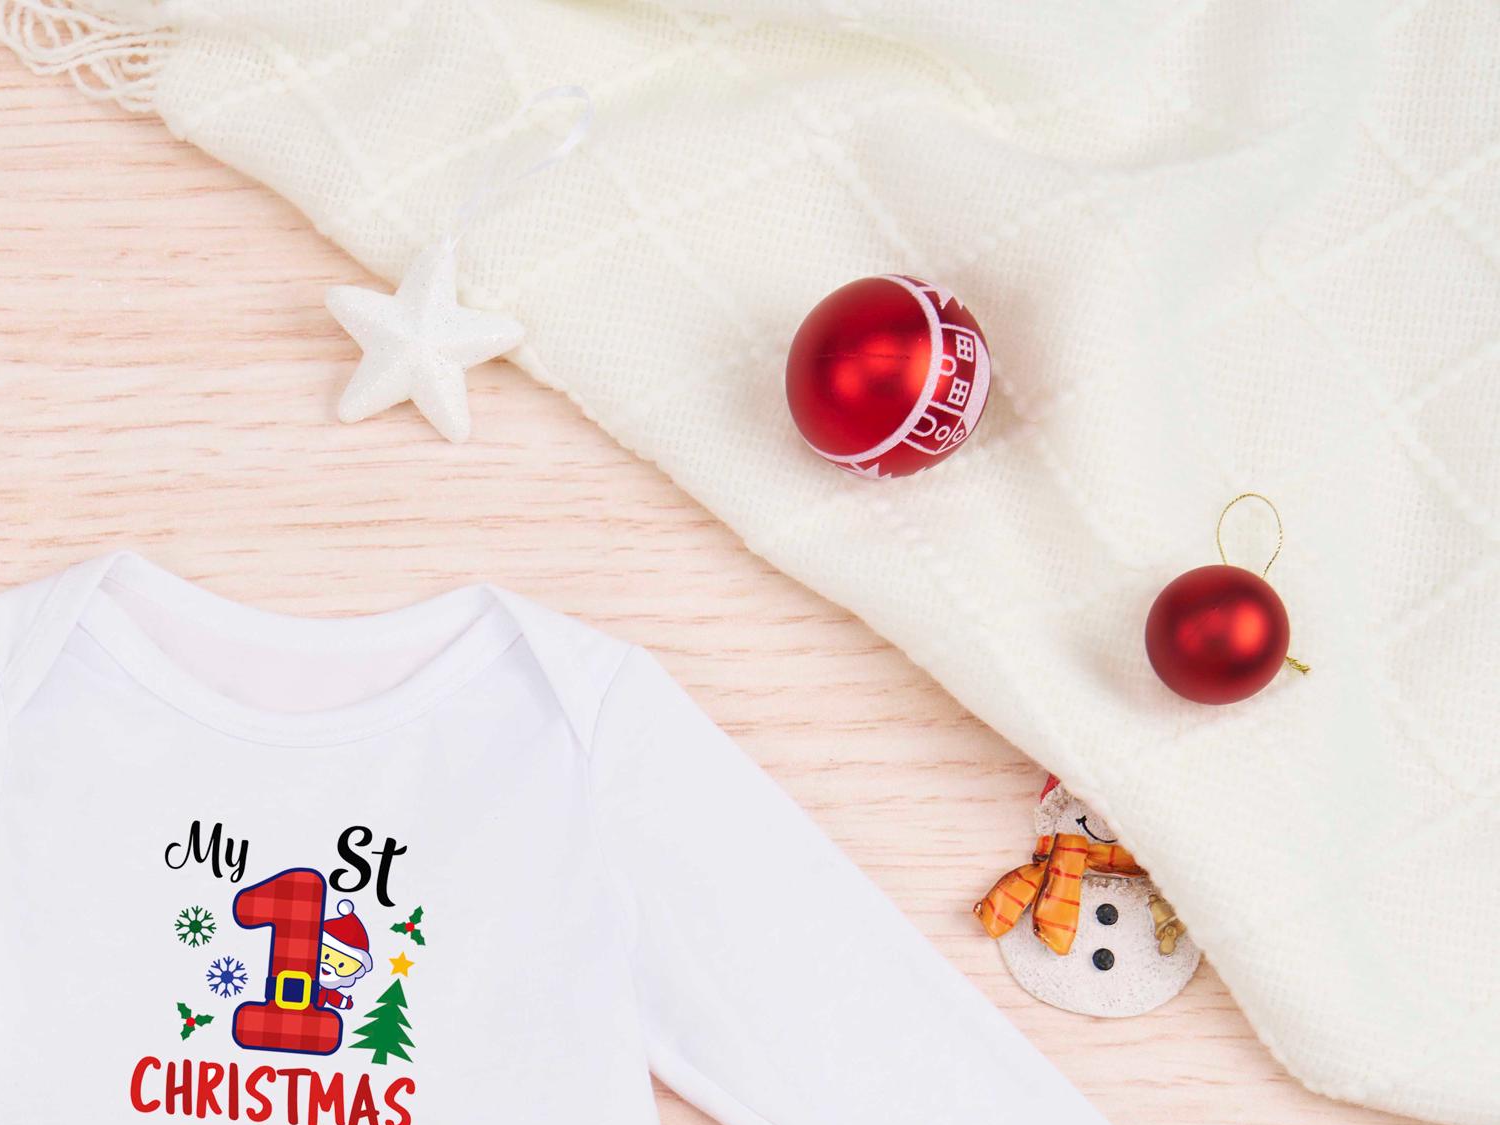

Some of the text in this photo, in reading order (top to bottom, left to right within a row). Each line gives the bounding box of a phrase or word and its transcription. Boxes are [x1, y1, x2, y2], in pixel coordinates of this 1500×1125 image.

[164, 820, 408, 1056] My 1 St
